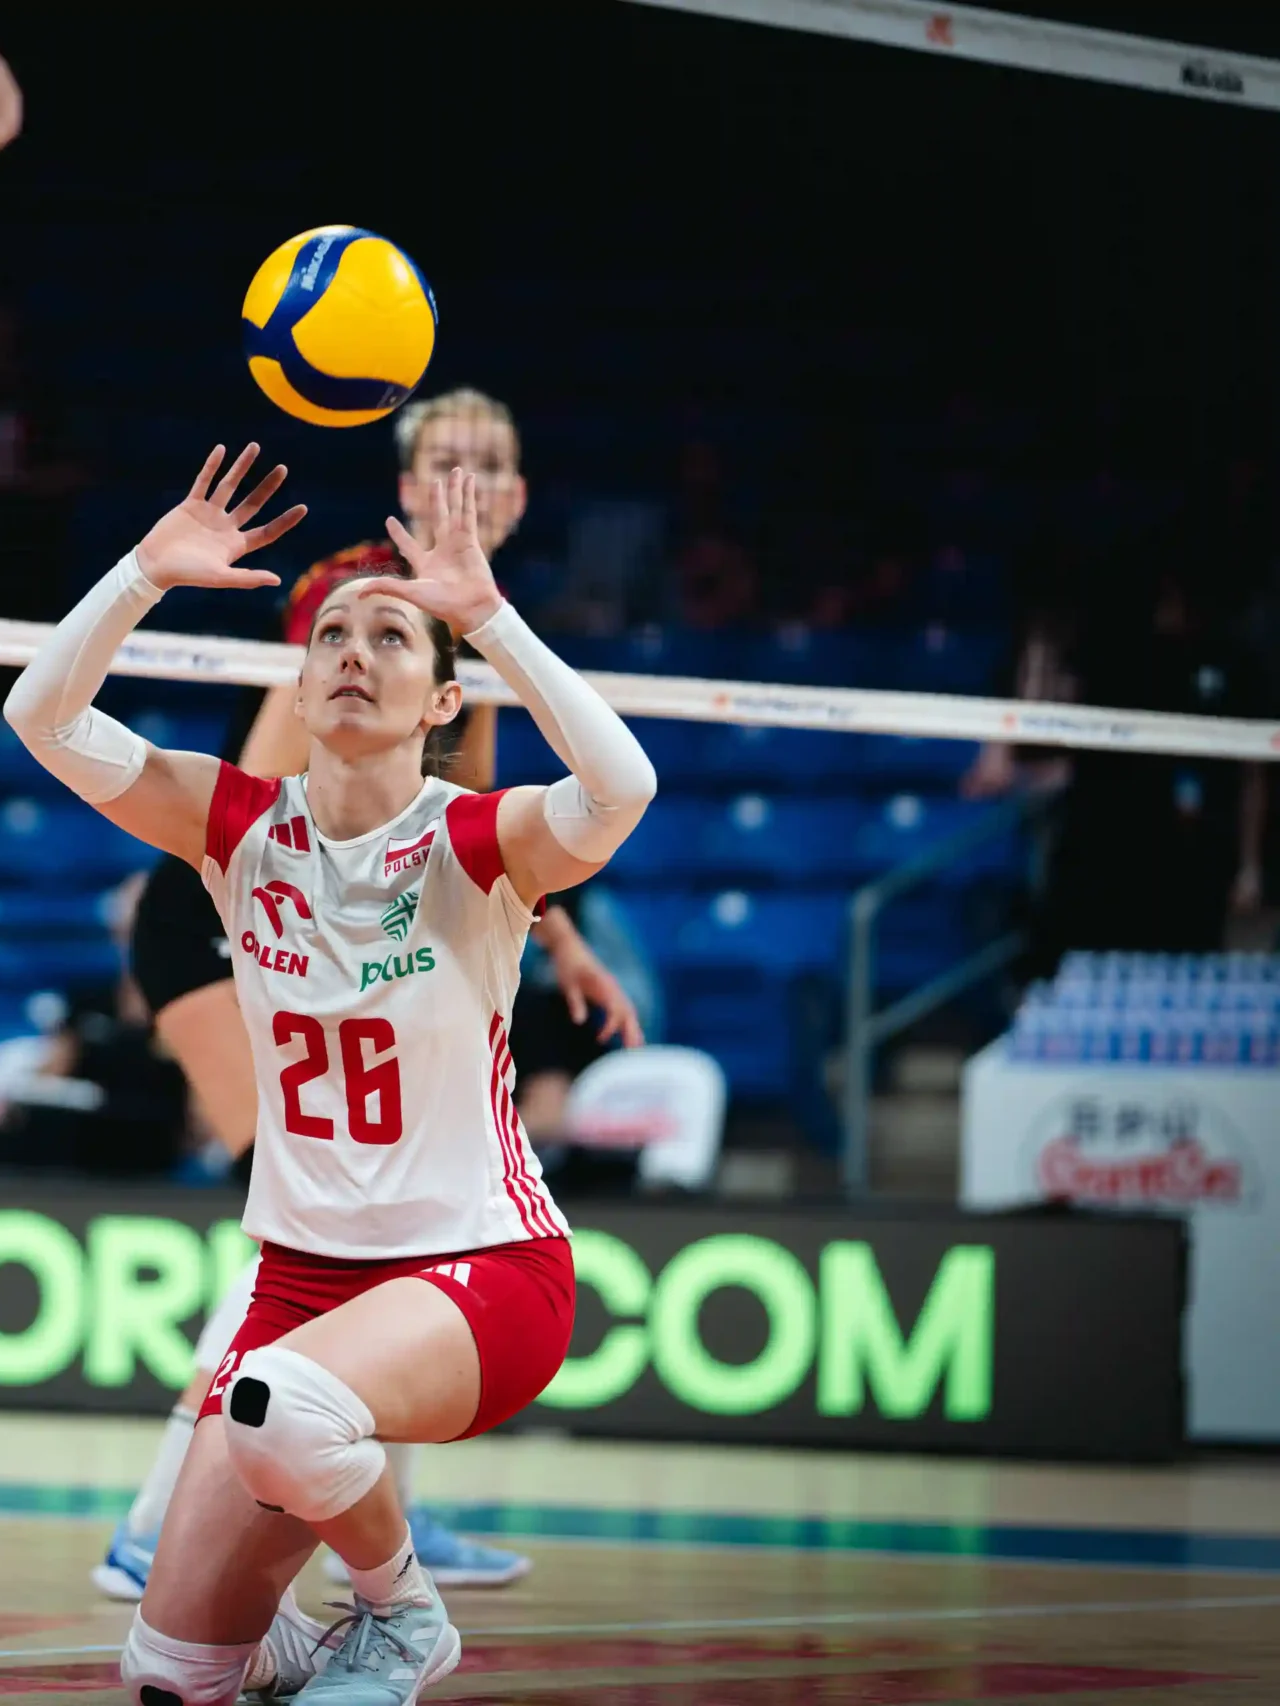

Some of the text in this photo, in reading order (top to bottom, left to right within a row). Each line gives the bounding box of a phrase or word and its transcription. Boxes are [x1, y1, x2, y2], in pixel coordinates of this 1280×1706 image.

[241, 930, 310, 978] ORLEN
[359, 947, 436, 992] plus
[272, 1010, 402, 1145] 26
